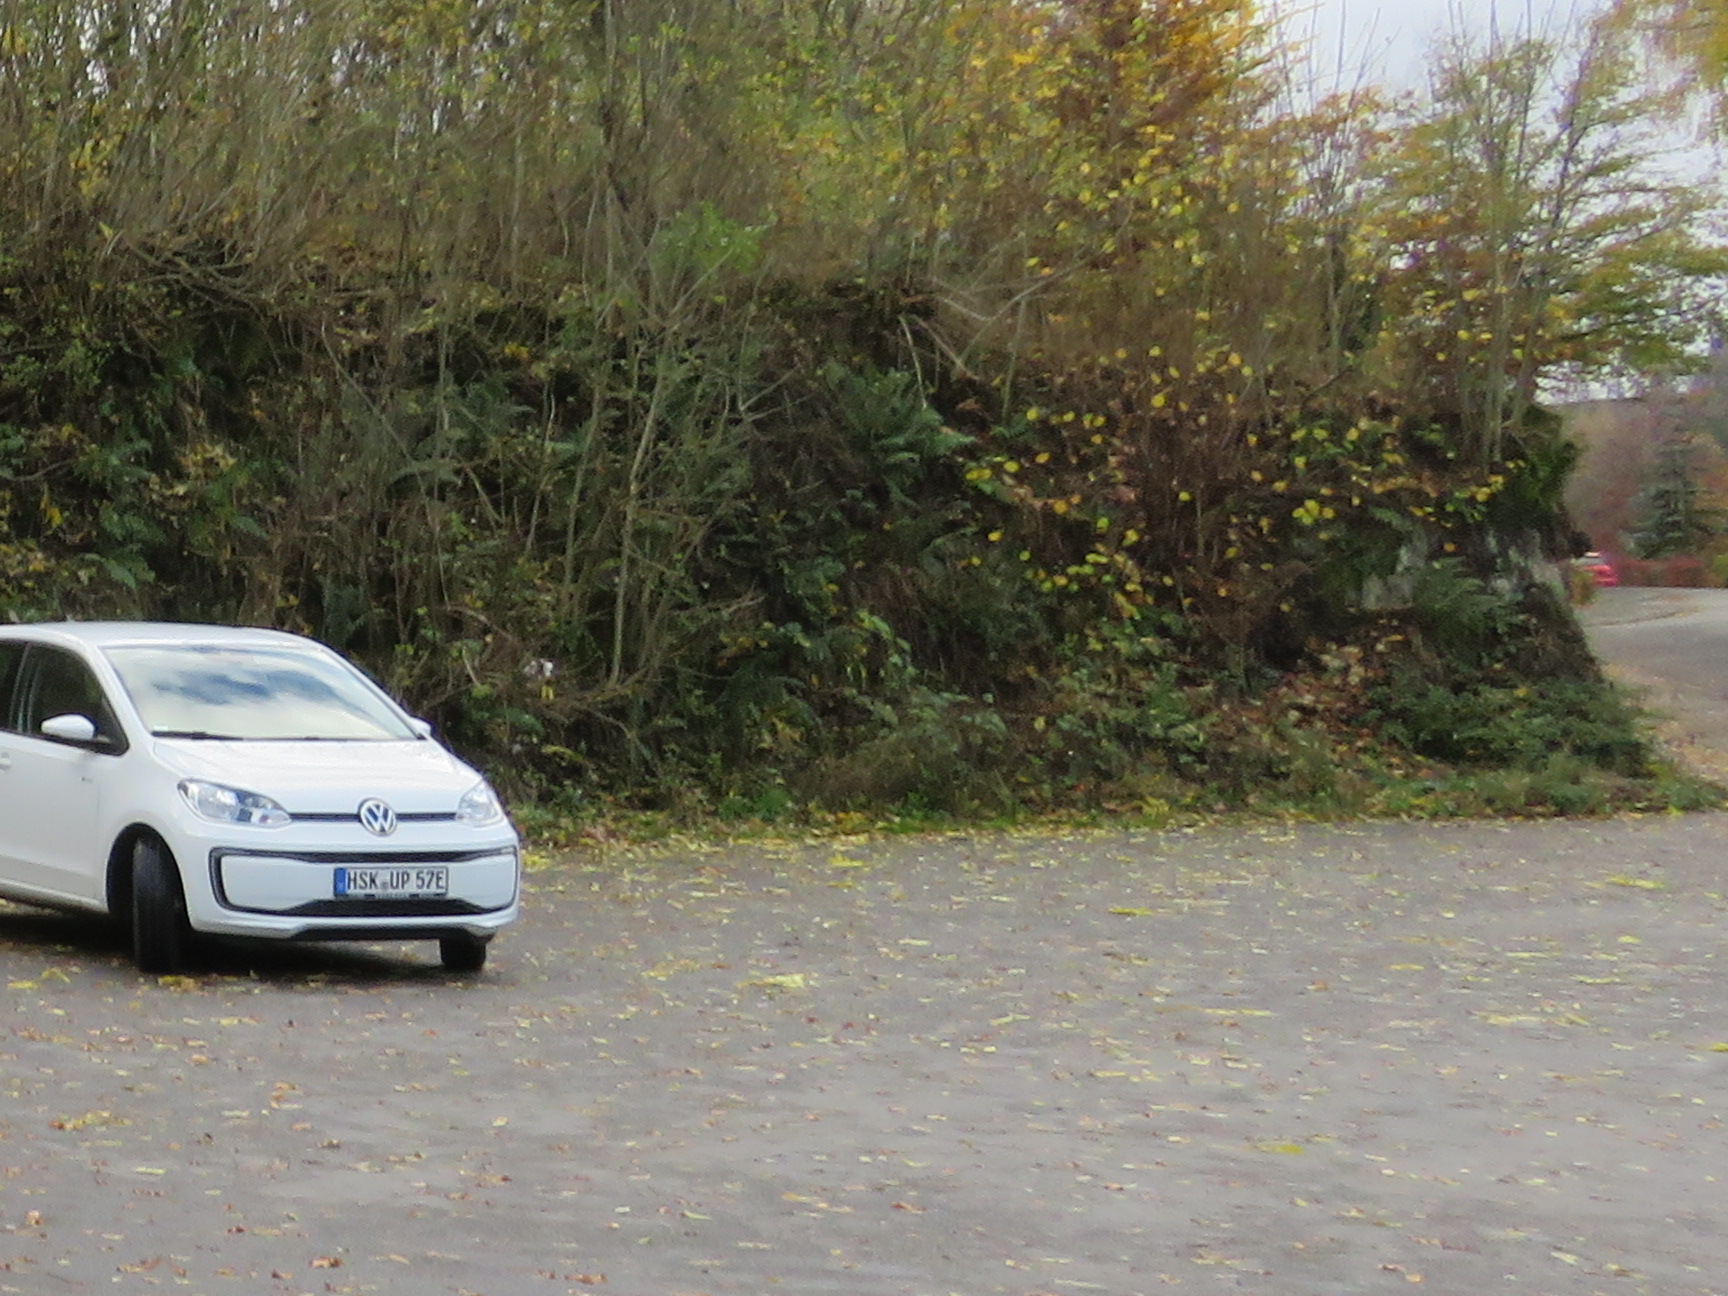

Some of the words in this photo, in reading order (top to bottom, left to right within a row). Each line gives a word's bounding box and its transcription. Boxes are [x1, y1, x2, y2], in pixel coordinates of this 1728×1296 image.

[359, 797, 397, 836] VW
[347, 871, 378, 890] HSK
[389, 871, 410, 890] UP
[415, 870, 445, 890] 57E
